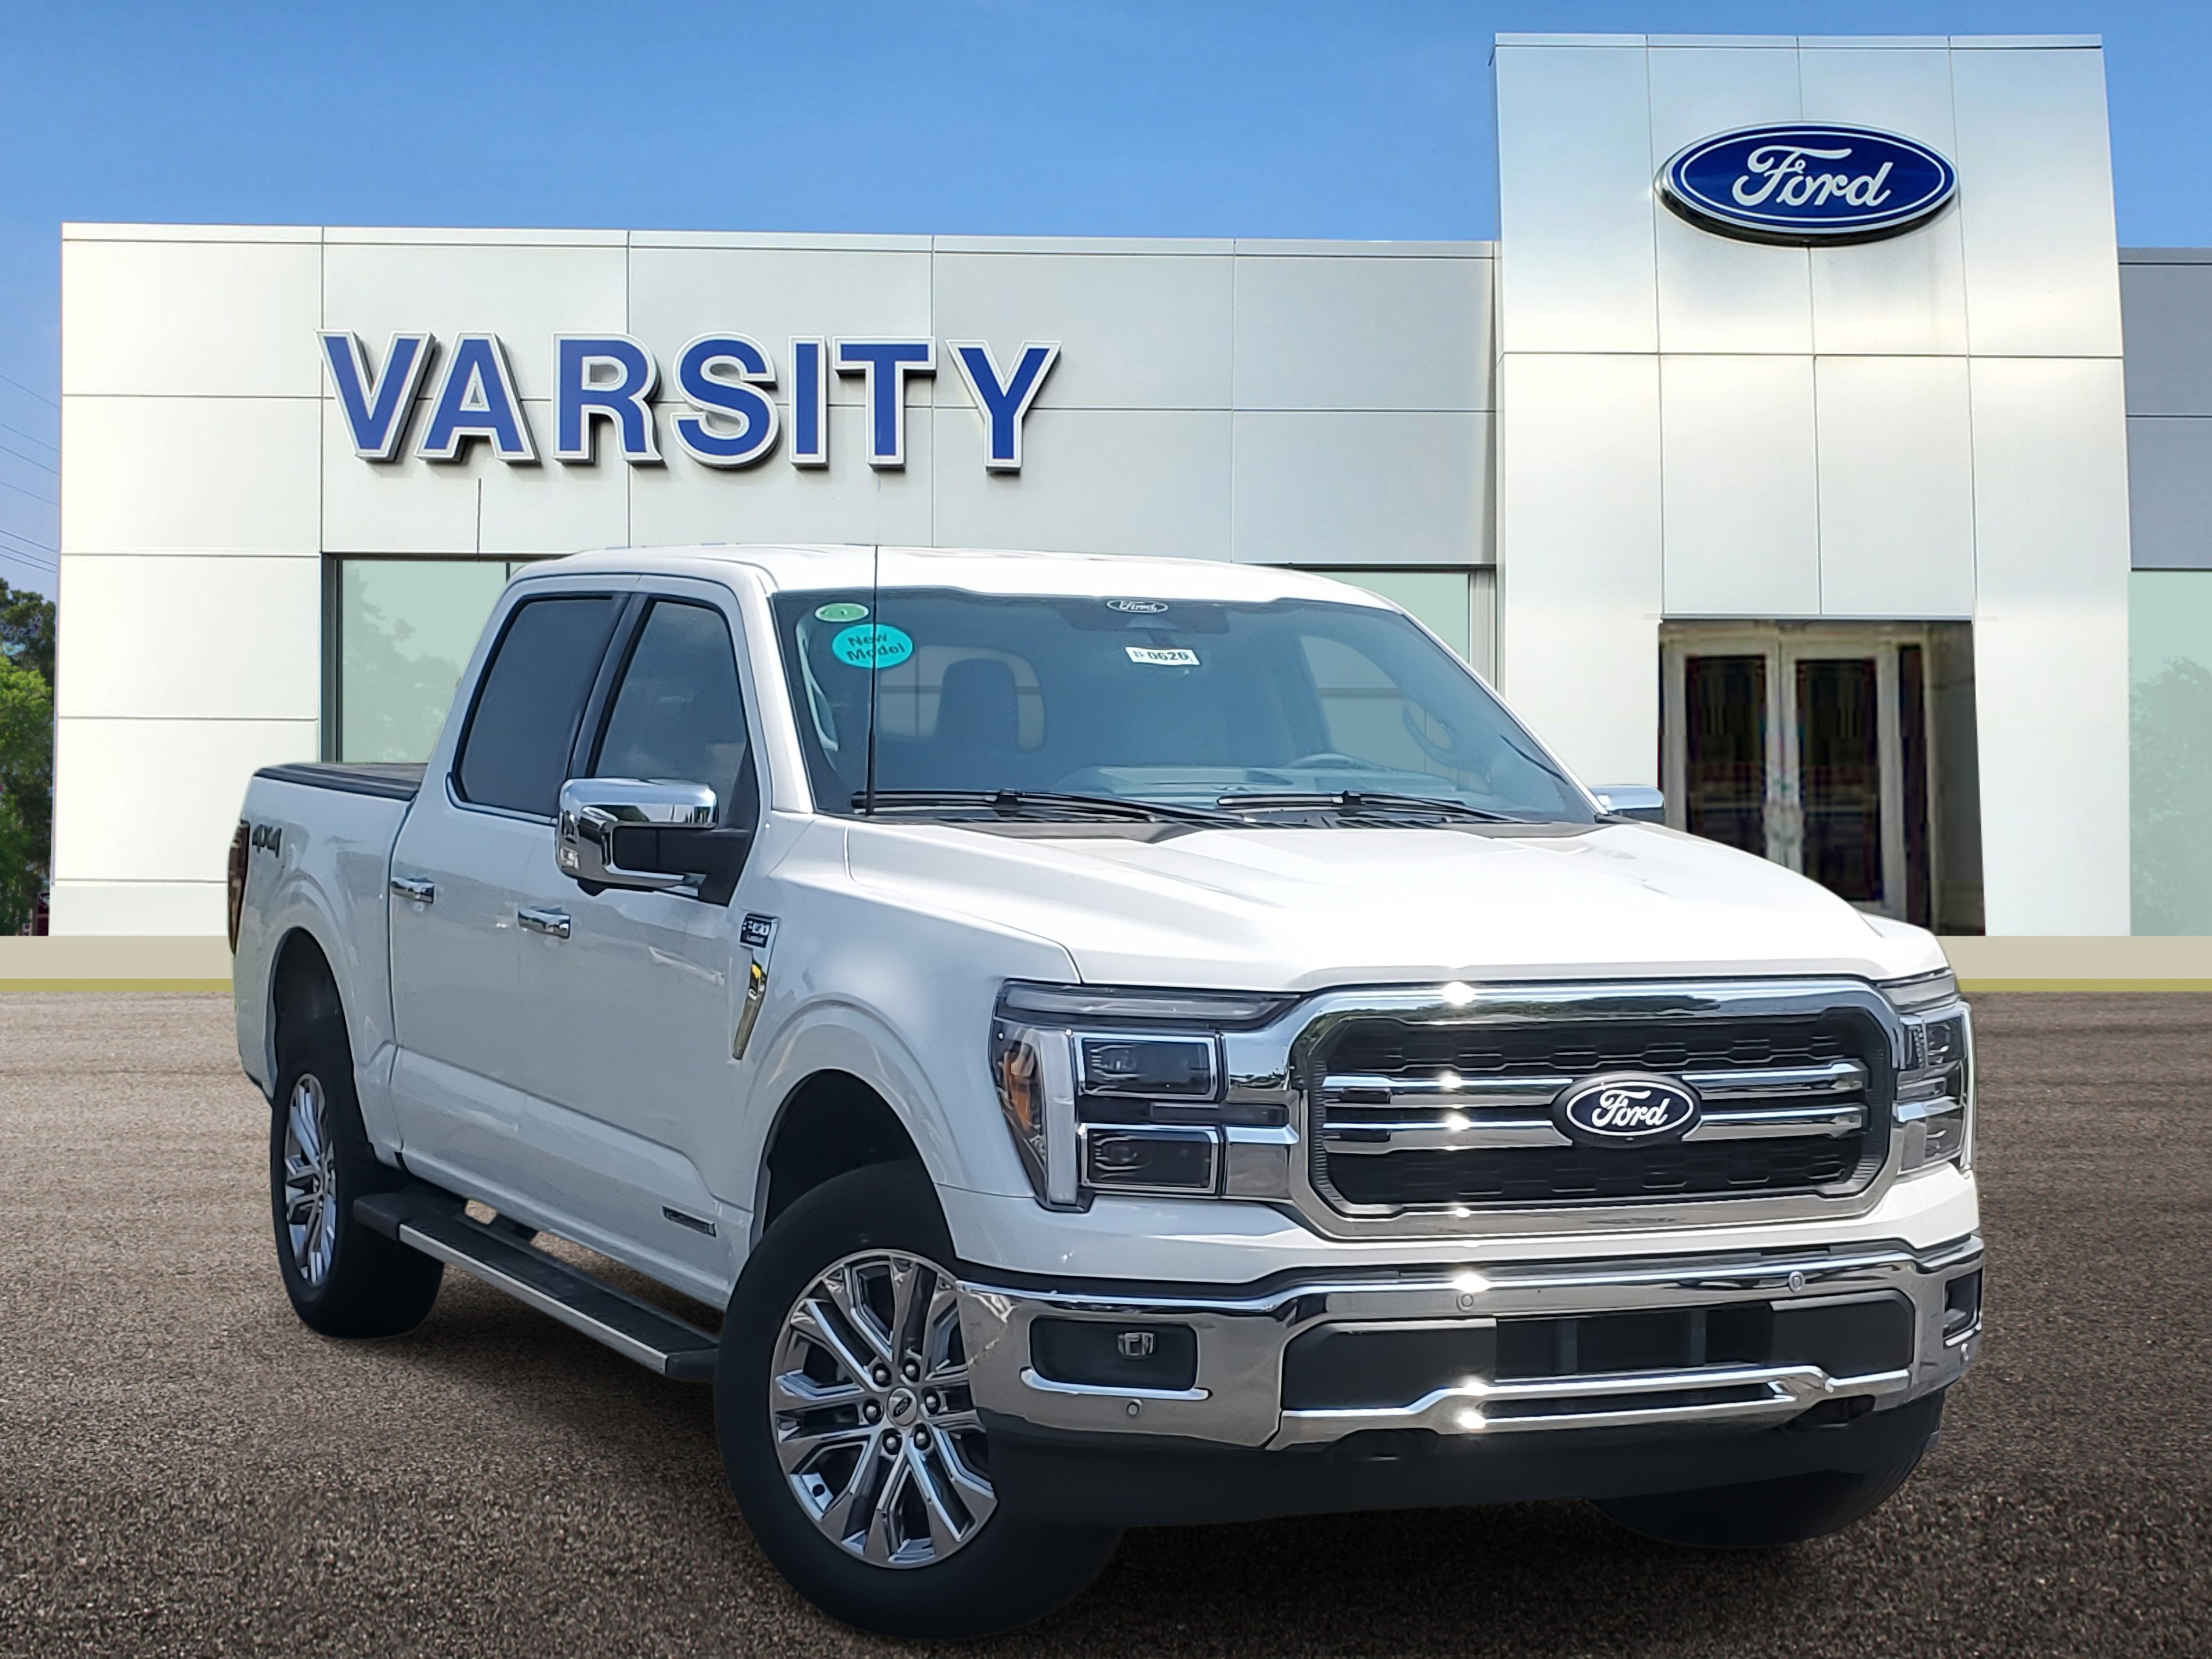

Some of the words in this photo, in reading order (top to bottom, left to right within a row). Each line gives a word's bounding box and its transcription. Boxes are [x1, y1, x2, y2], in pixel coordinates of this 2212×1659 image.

[1731, 144, 1894, 207] Ford
[313, 329, 1061, 474] VARSITY
[846, 643, 905, 661] Model
[847, 633, 887, 647] New
[1592, 1089, 1671, 1127] Ford
